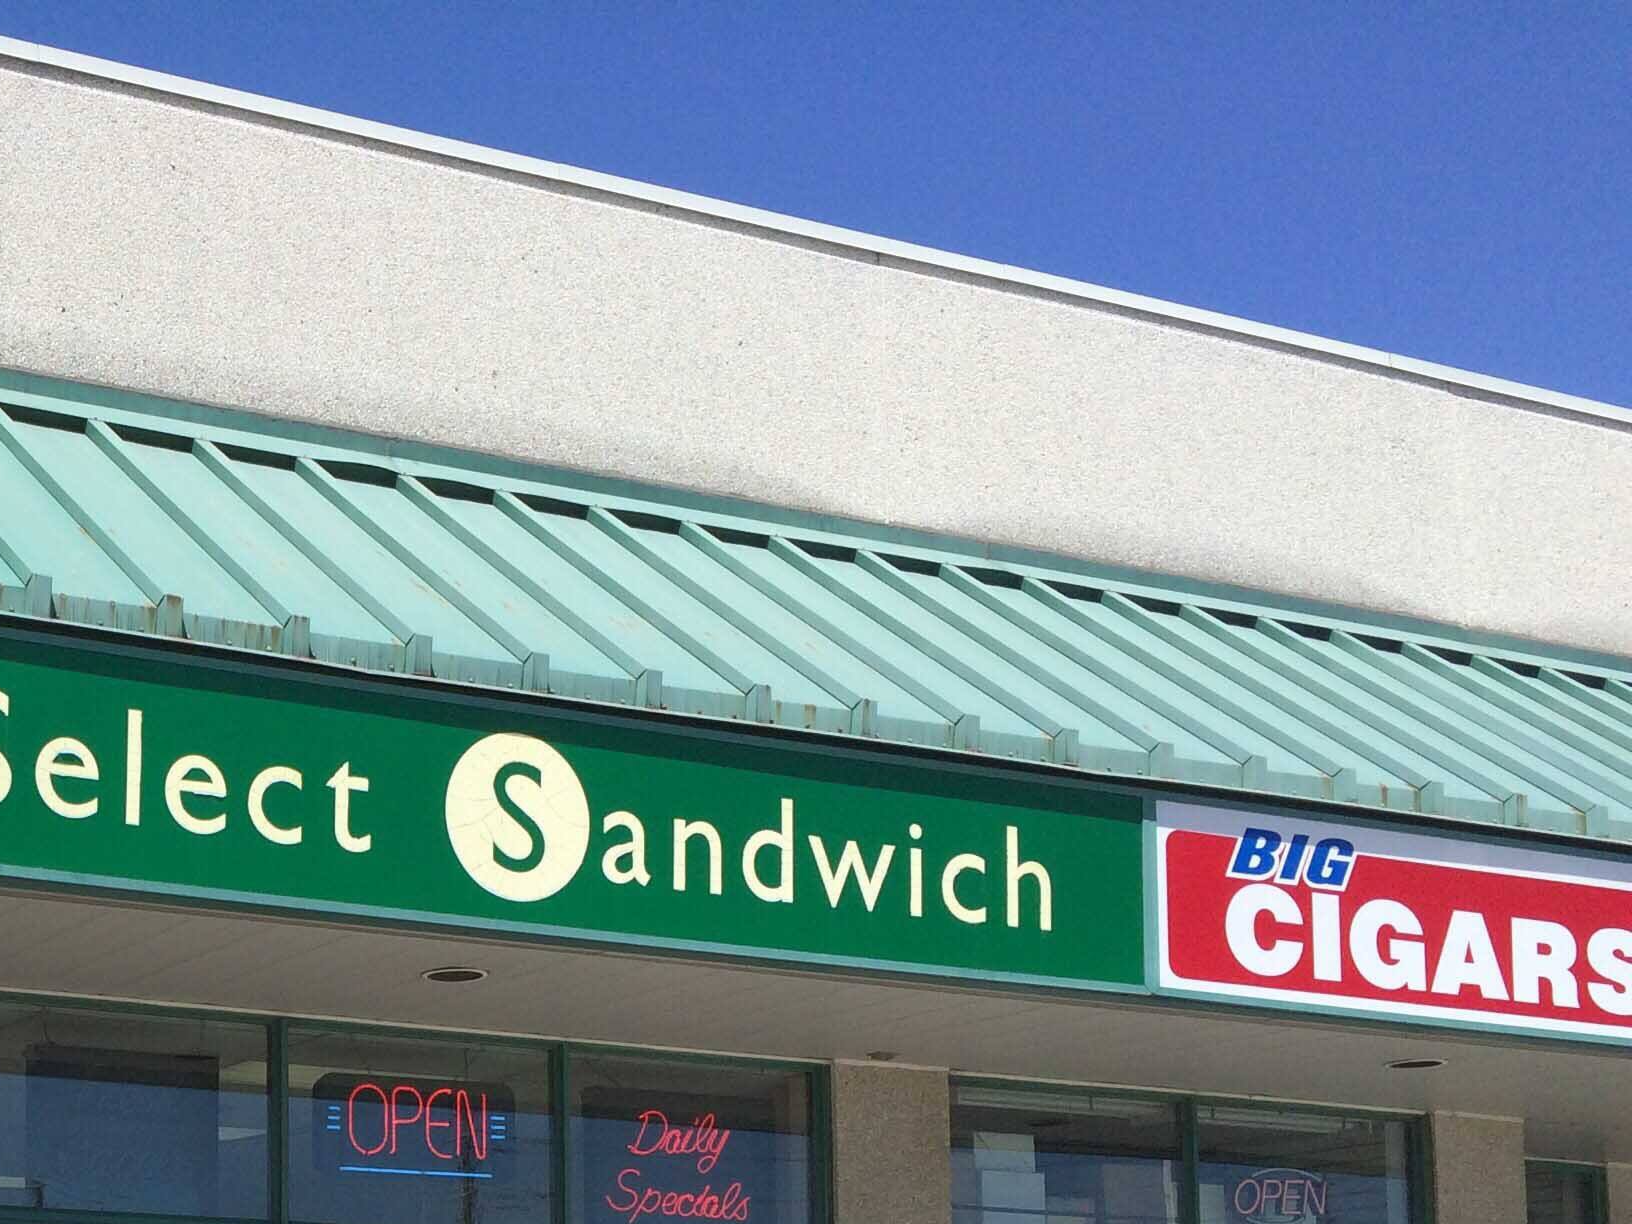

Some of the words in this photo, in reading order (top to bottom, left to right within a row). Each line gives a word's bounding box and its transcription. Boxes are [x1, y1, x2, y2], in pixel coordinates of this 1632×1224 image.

[490, 760, 1053, 932] Sandwich
[1229, 827, 1355, 887] BIG
[1224, 884, 1632, 1016] CIGARS
[348, 1083, 489, 1161] OPEN
[626, 1110, 731, 1174] Daily
[605, 1168, 752, 1224] Specials
[1234, 1178, 1328, 1216] OPEN
